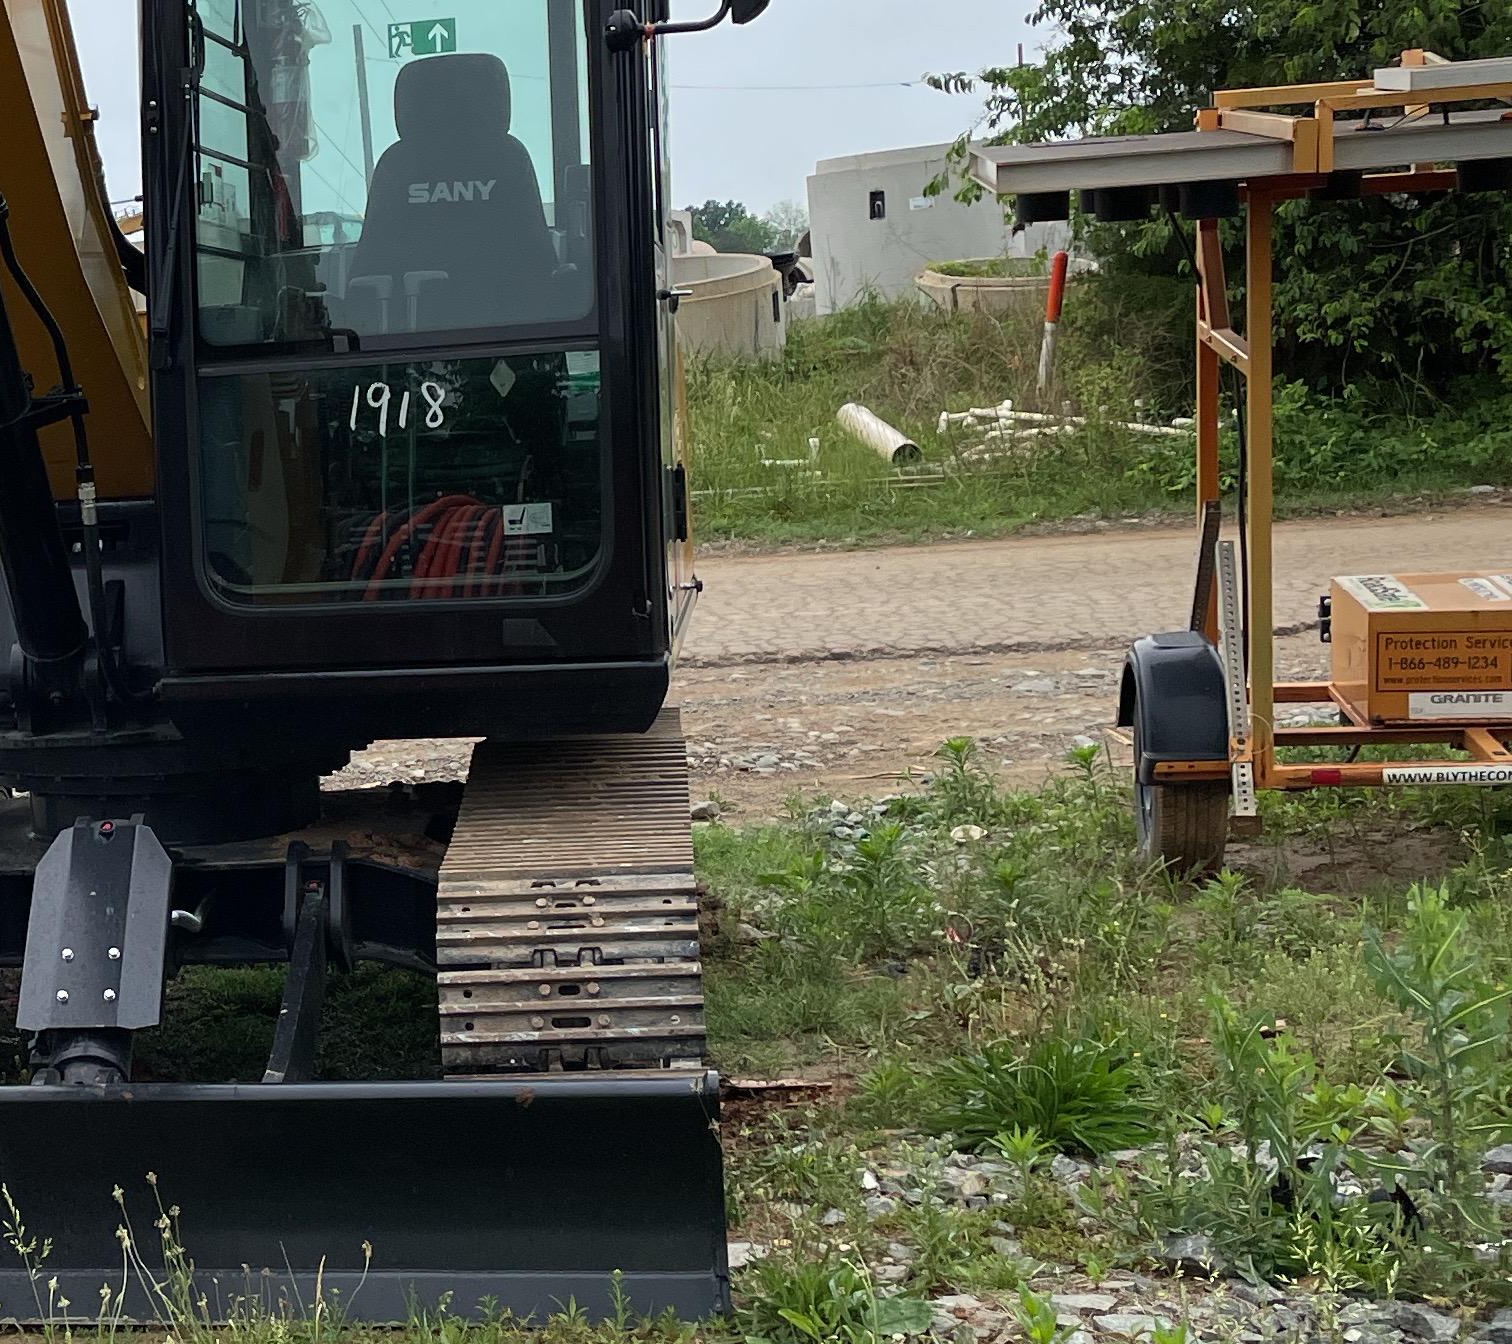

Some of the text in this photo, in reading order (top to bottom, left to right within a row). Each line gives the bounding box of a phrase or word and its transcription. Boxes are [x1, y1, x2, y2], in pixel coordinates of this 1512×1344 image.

[407, 179, 496, 204] SANY
[349, 382, 446, 438] 1918
[1384, 637, 1457, 651] Protection
